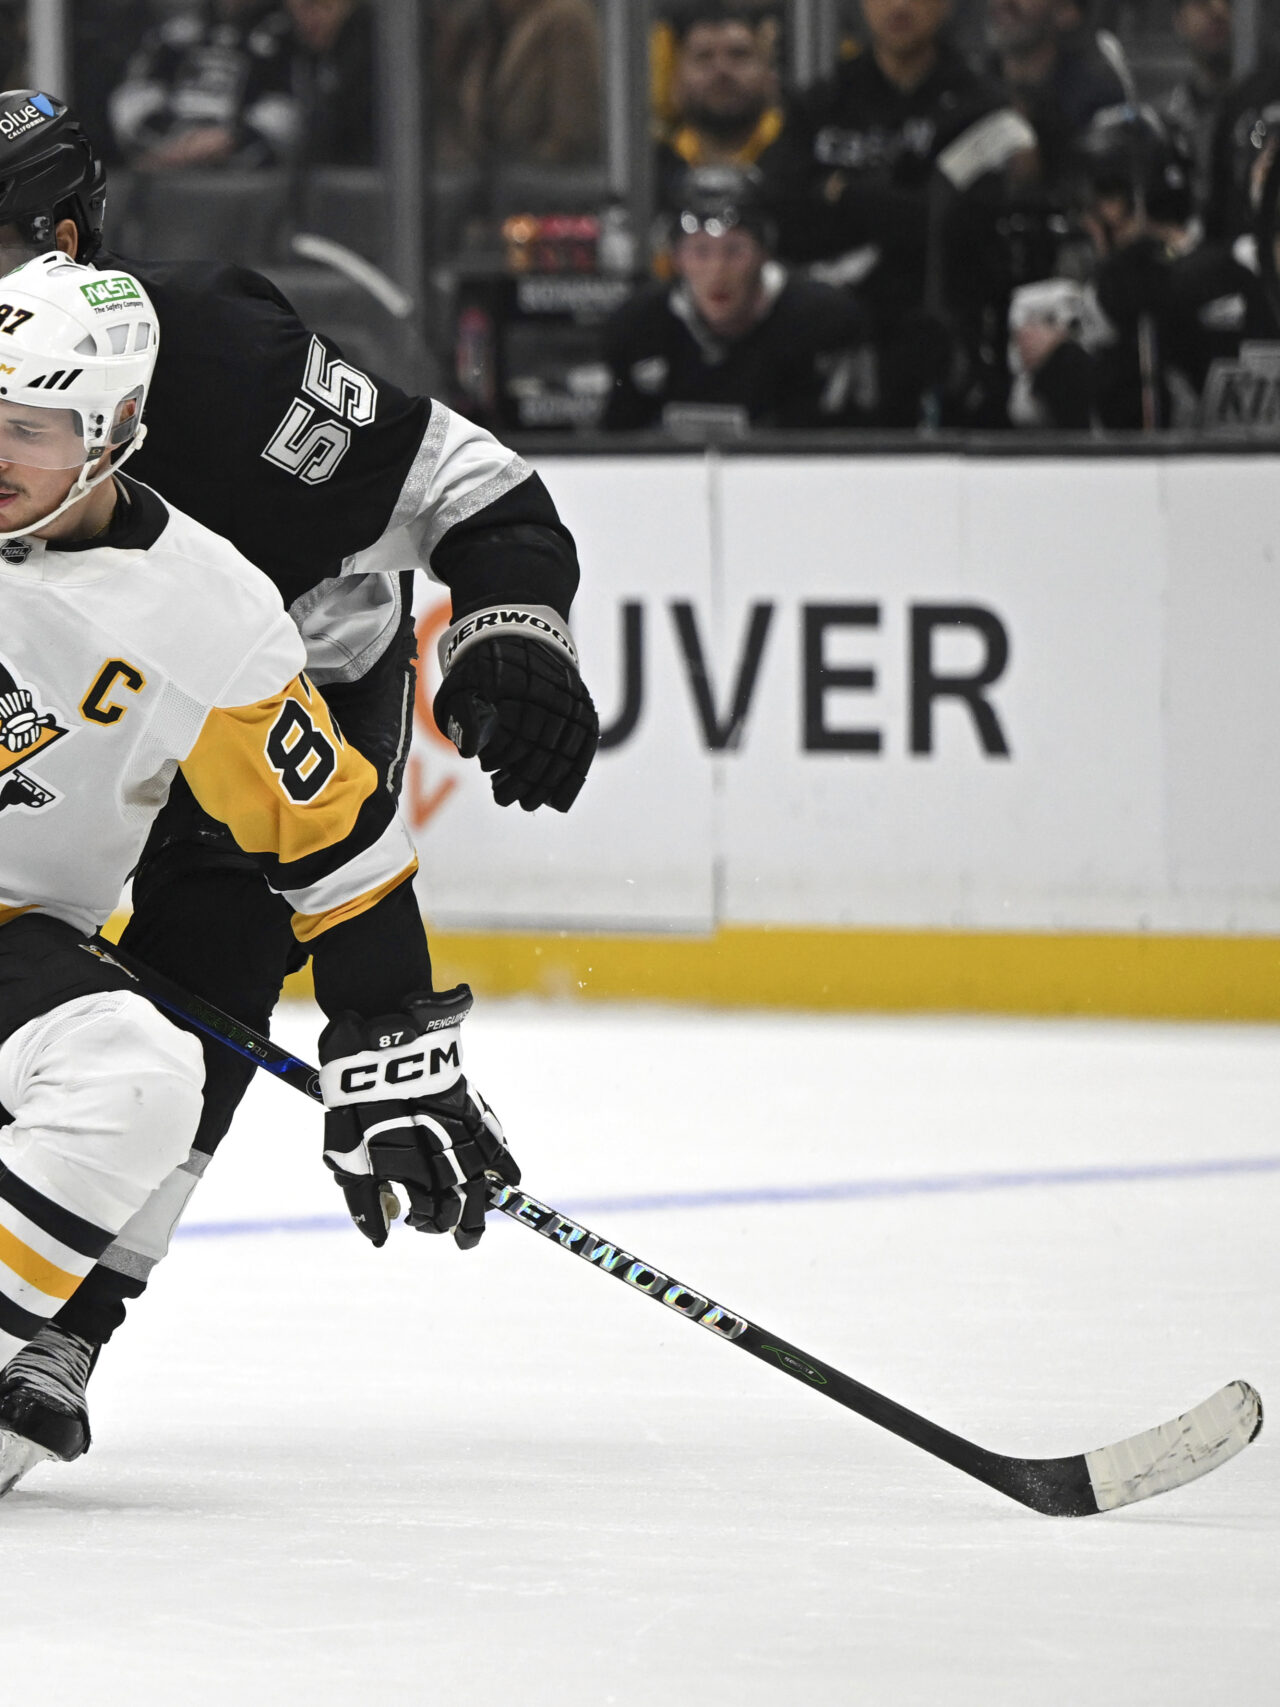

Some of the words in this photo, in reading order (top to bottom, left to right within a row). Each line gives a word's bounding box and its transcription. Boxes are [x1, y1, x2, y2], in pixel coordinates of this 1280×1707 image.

[7, 116, 46, 140] CALIFORNIA
[85, 280, 139, 303] MSA
[94, 307, 106, 315] The
[105, 303, 123, 312] Safety
[261, 334, 378, 486] 55
[77, 656, 147, 728] C
[263, 670, 345, 805] 8
[425, 1008, 470, 1032] PENGUINS
[379, 1032, 404, 1048] 87
[340, 1041, 460, 1094] CCM
